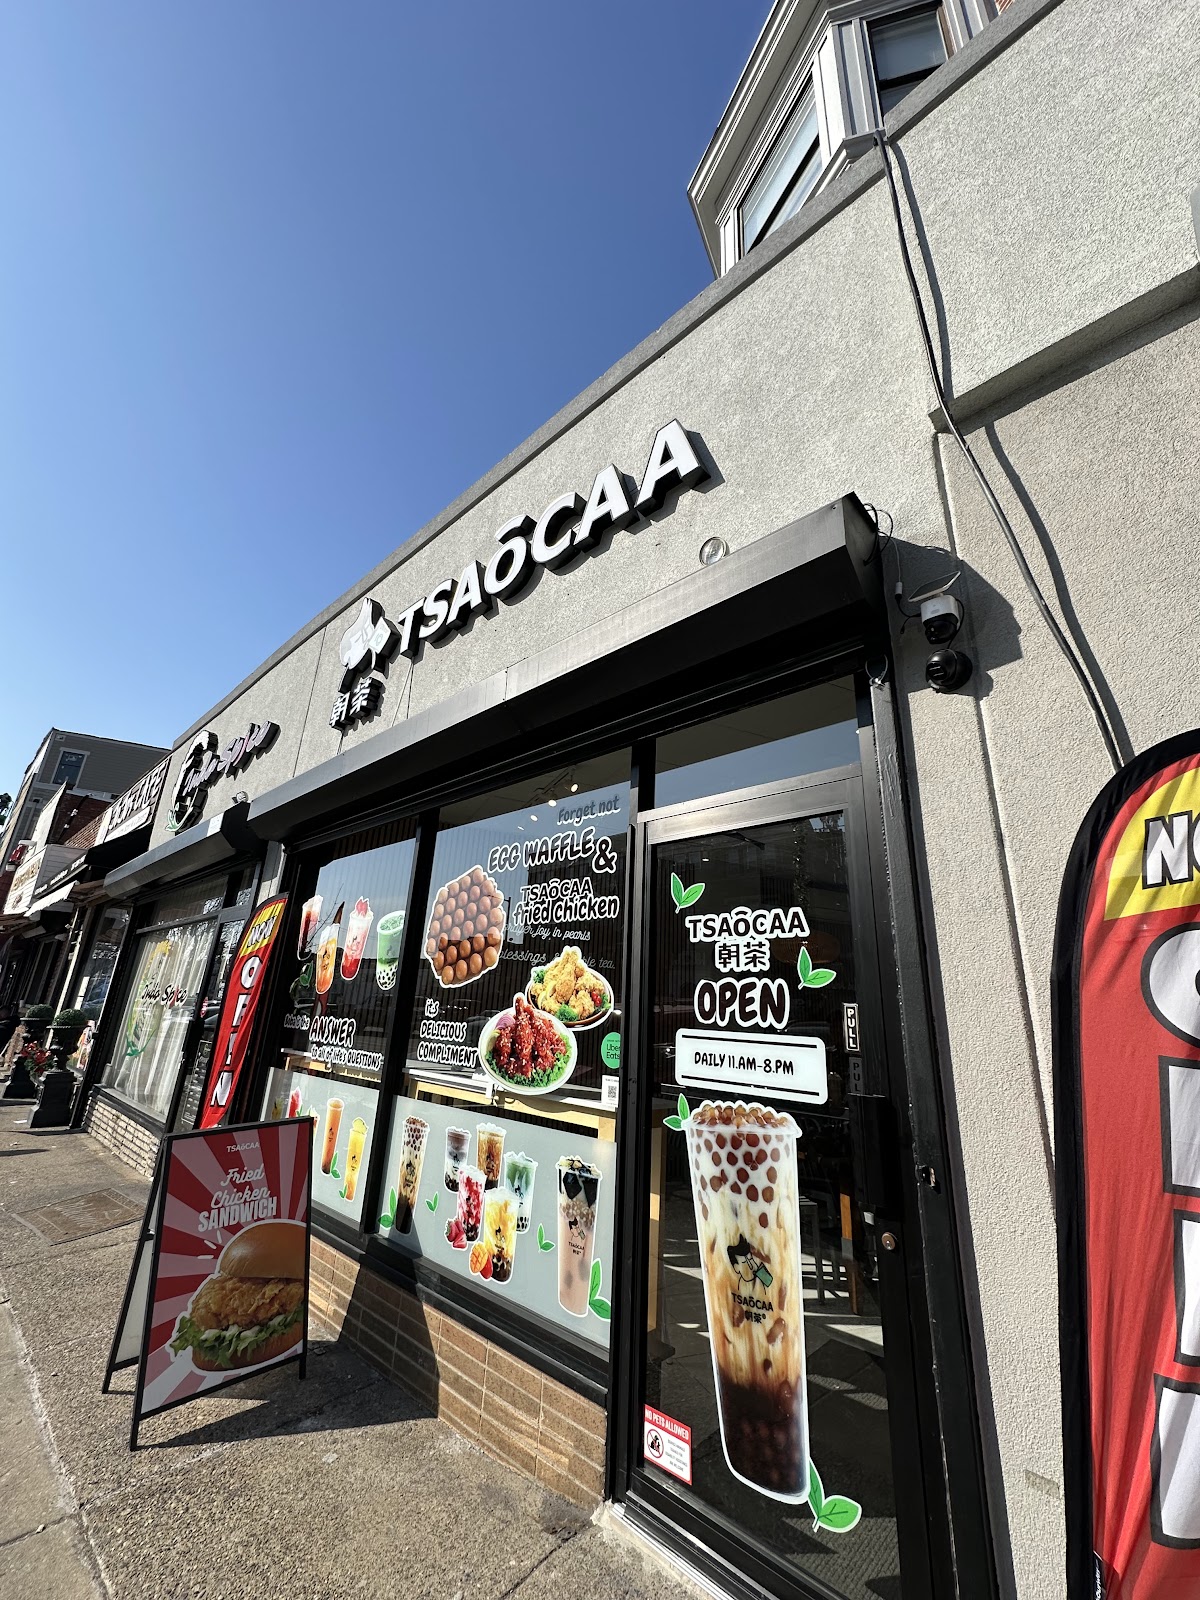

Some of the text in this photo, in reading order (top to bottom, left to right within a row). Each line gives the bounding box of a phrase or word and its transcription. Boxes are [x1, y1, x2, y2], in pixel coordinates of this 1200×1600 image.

[598, 795, 621, 816] not
[487, 826, 595, 874] EGG WAFFLE
[592, 836, 617, 874] &
[513, 895, 620, 926] fried chicken
[694, 977, 790, 1029] OPEN
[309, 1015, 356, 1048] ANSWER
[420, 1020, 467, 1042] DELICIOUS
[846, 1008, 857, 1048] PULL
[346, 1048, 383, 1071] QUESTIONS
[417, 1041, 479, 1068] COMPLIMENT
[694, 1051, 725, 1068] DAILY
[220, 1163, 265, 1187] Fried
[210, 1185, 271, 1209] Chicken
[197, 1196, 277, 1232] SANDWICH
[645, 1408, 690, 1441] NO PETS ALLOWED
